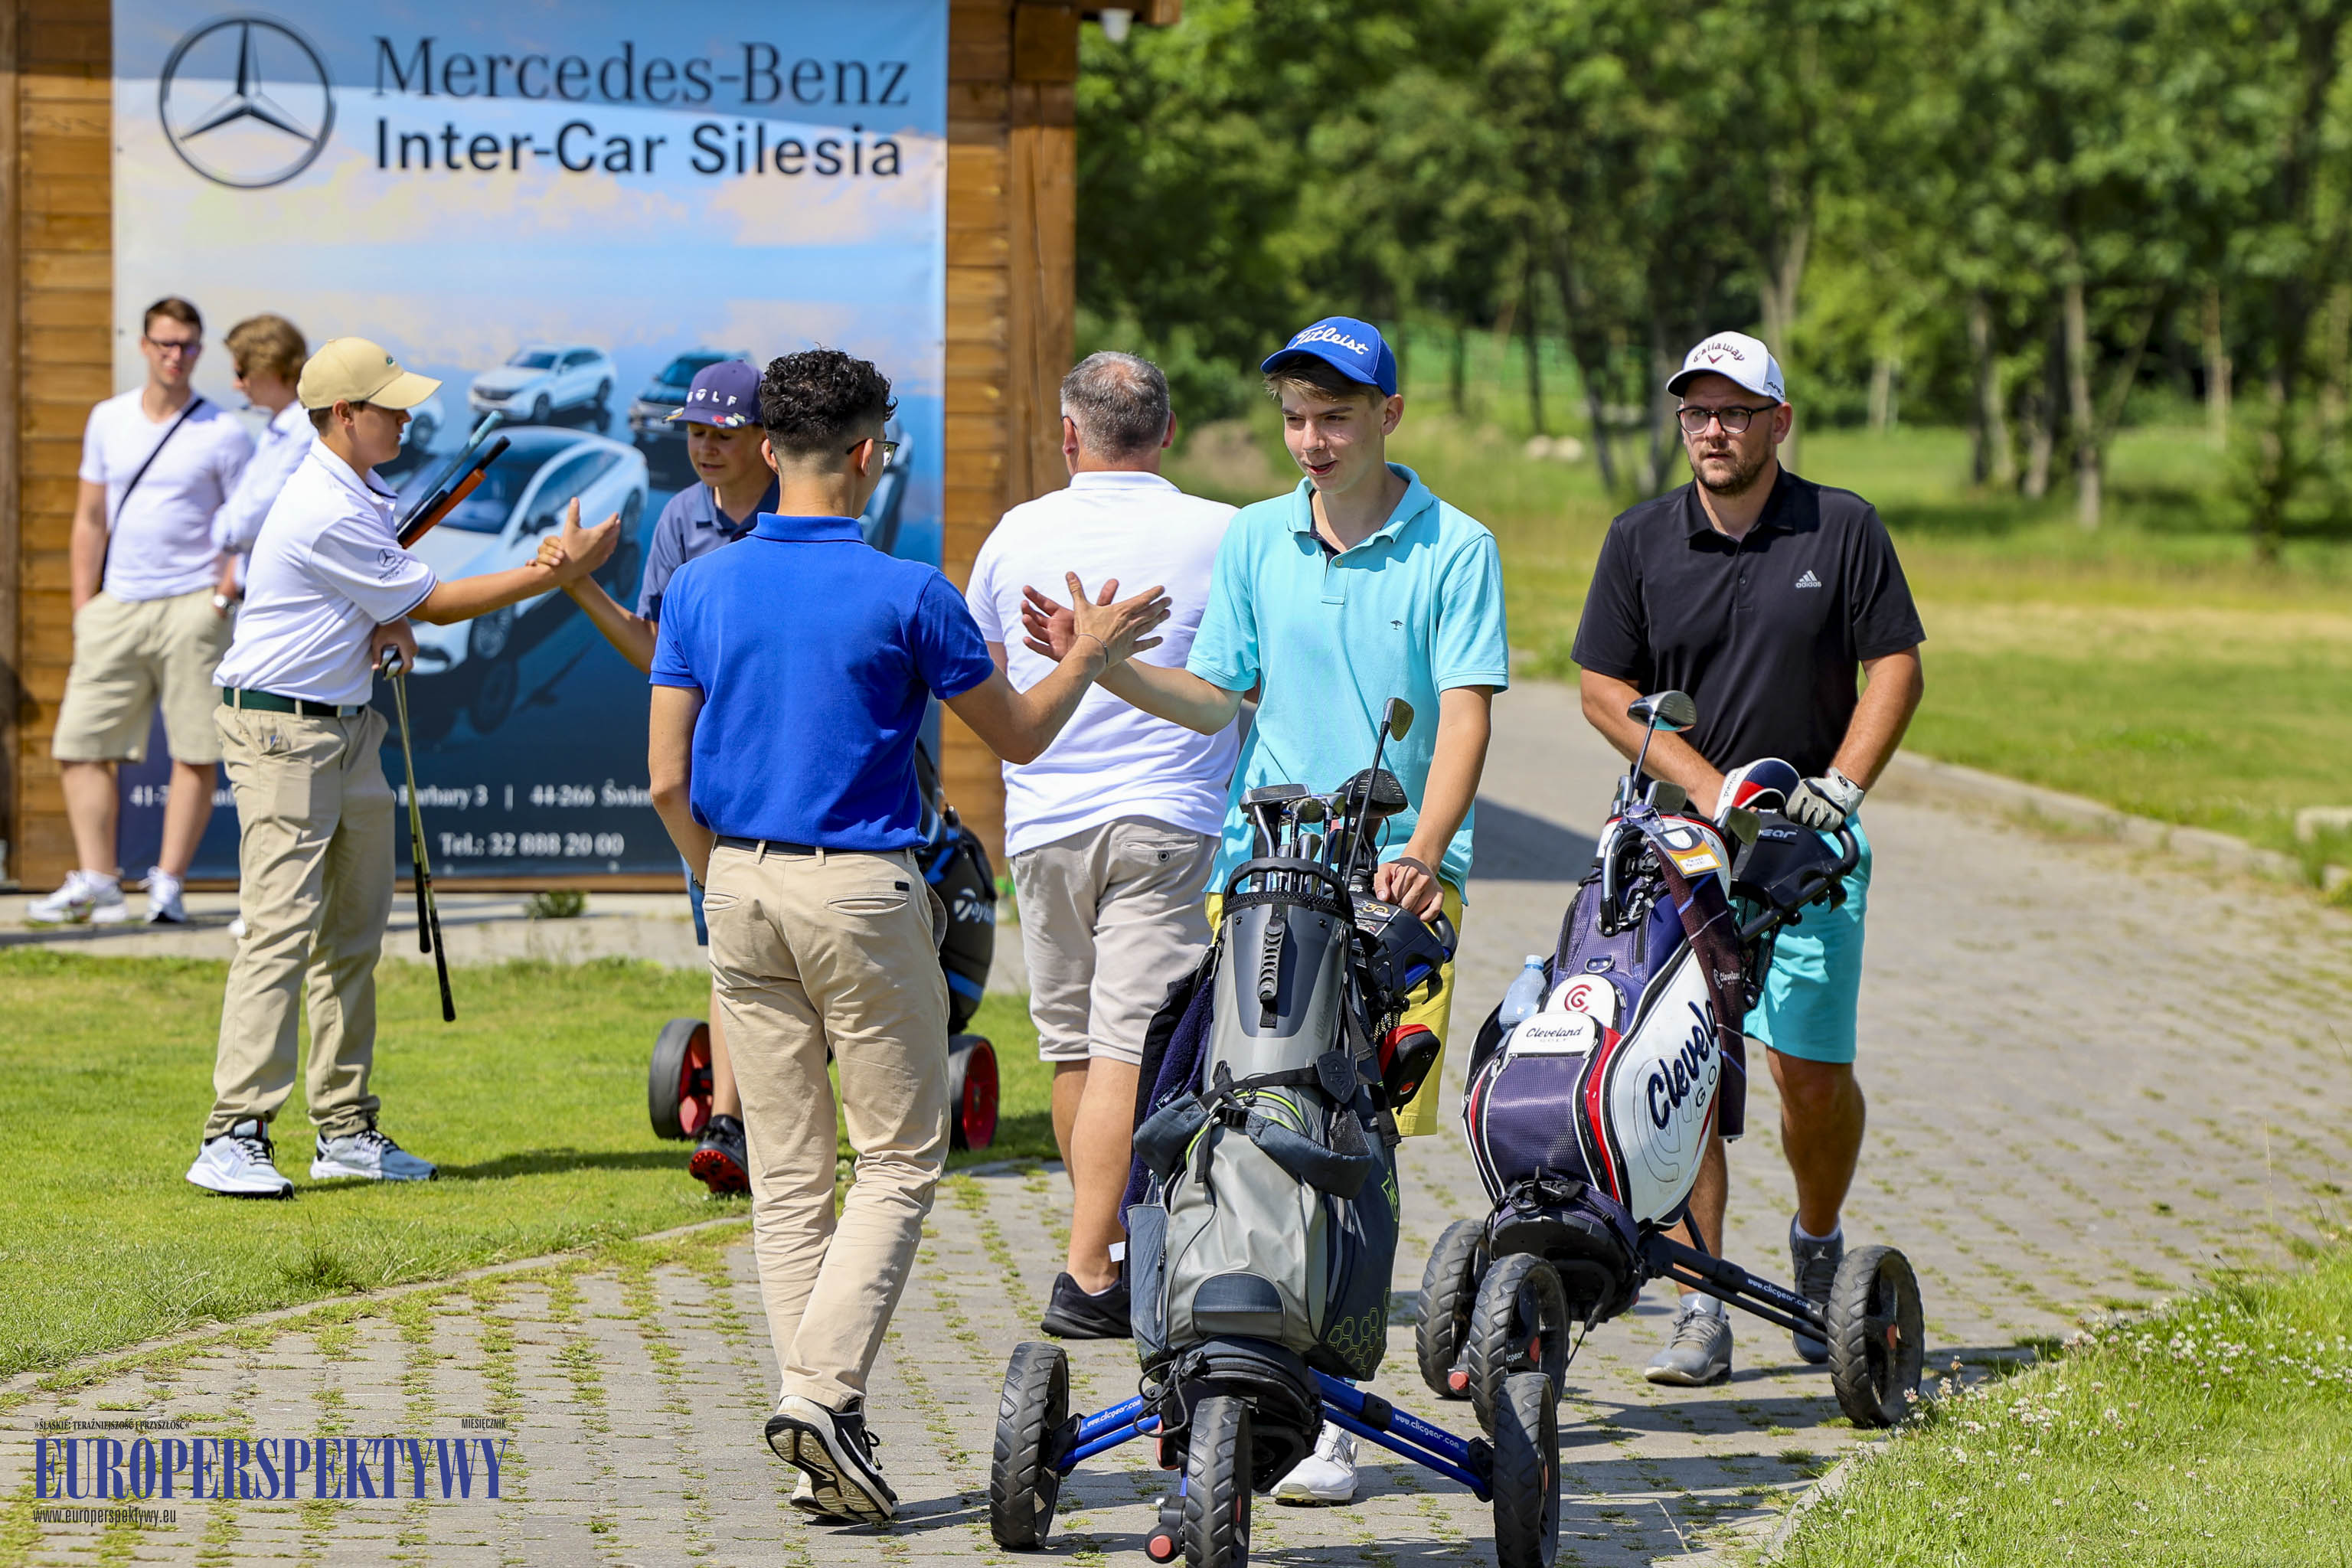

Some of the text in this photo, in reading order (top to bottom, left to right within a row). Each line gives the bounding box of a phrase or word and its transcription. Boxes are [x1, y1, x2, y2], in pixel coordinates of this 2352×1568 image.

[373, 36, 911, 107] Mercedes-Benz
[377, 116, 901, 177] Inter-Car Silesia
[1289, 324, 1370, 355] Titleist
[1693, 342, 1746, 363] Callaway
[1795, 580, 1822, 589] adidas
[487, 831, 516, 857] 32
[564, 831, 593, 857] 20
[1526, 1026, 1583, 1037] Cleveland
[1648, 999, 1718, 1130] Clevela
[1395, 1413, 1459, 1449] www.clicgear.com
